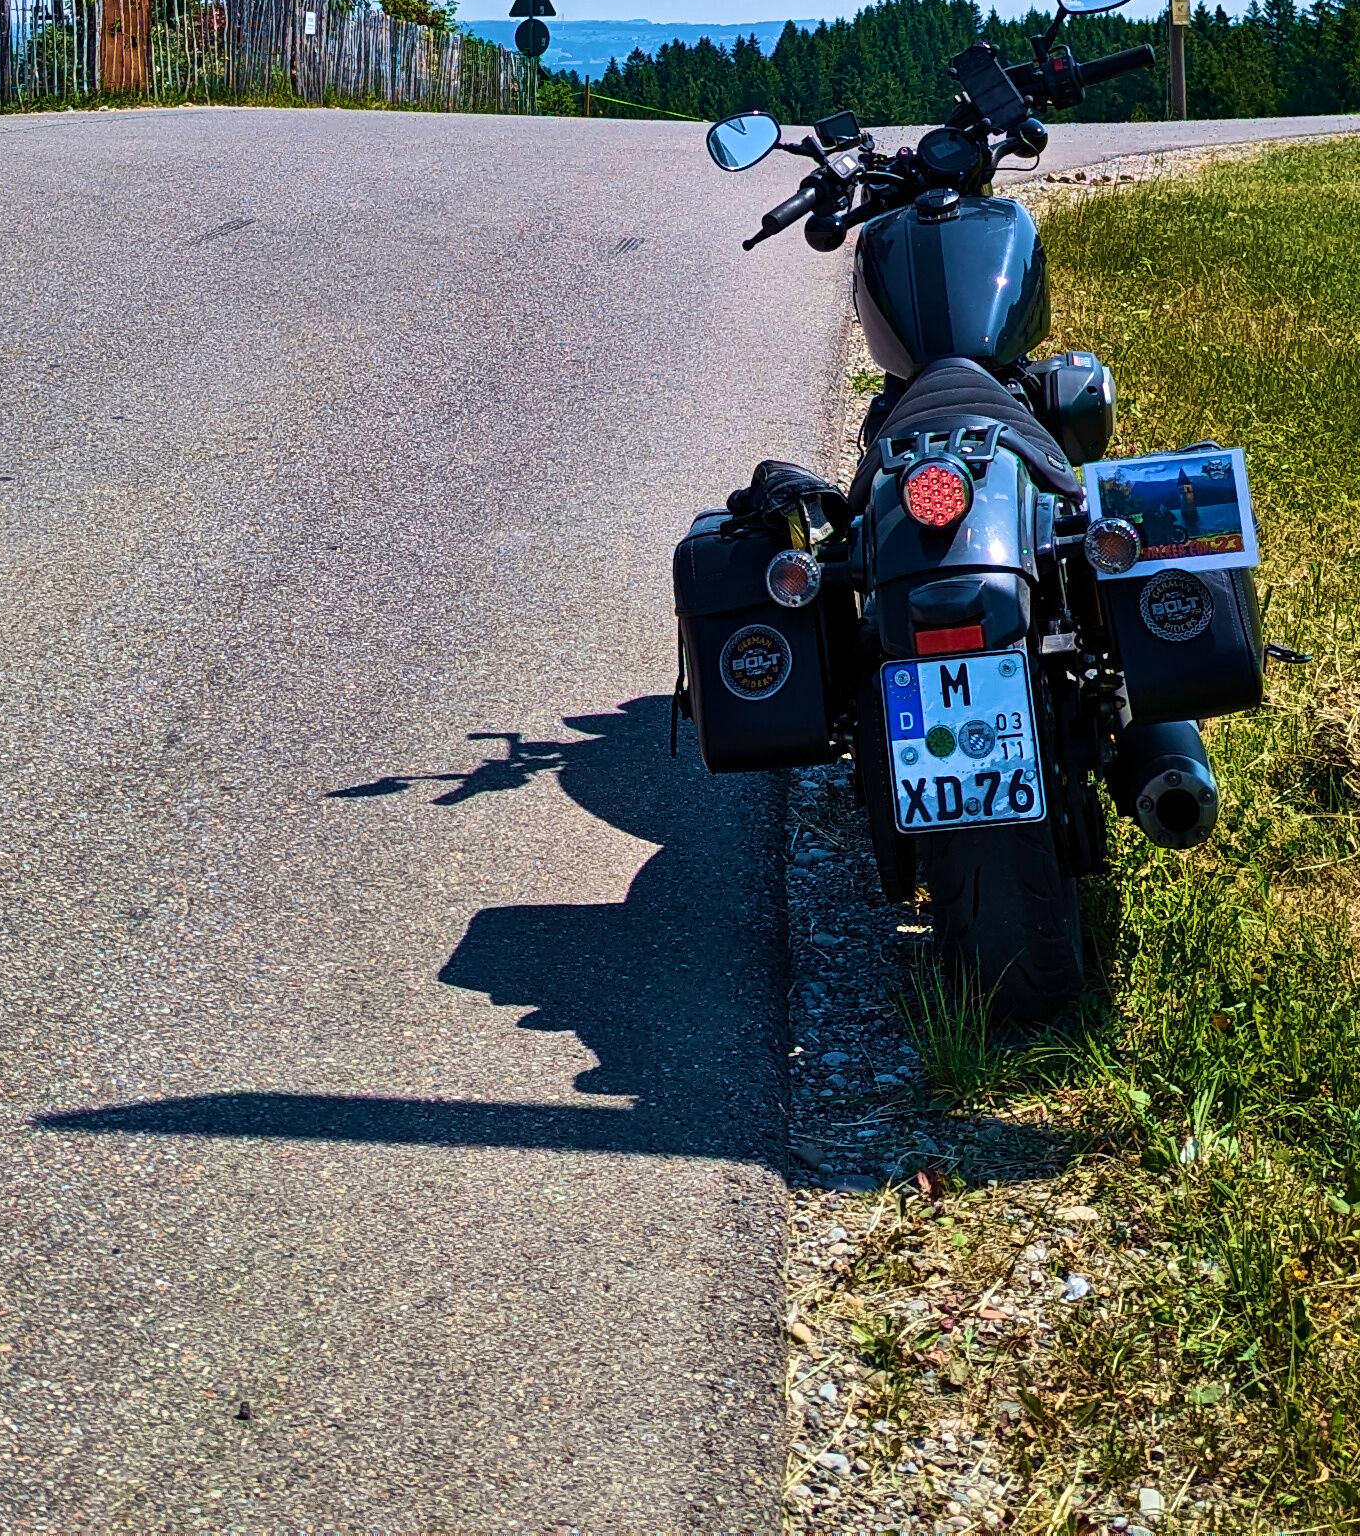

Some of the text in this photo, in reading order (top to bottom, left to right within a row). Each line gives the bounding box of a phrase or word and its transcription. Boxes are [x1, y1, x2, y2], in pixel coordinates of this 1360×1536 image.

[1151, 596, 1200, 615] BOLT
[1164, 618, 1197, 633] RIDERS
[737, 635, 773, 652] GERMAN
[732, 653, 781, 671] BOLT
[940, 662, 971, 708] M
[899, 712, 914, 731] D
[995, 712, 1023, 731] 03
[1001, 741, 1024, 760] 11
[902, 768, 1035, 824] XD 76
